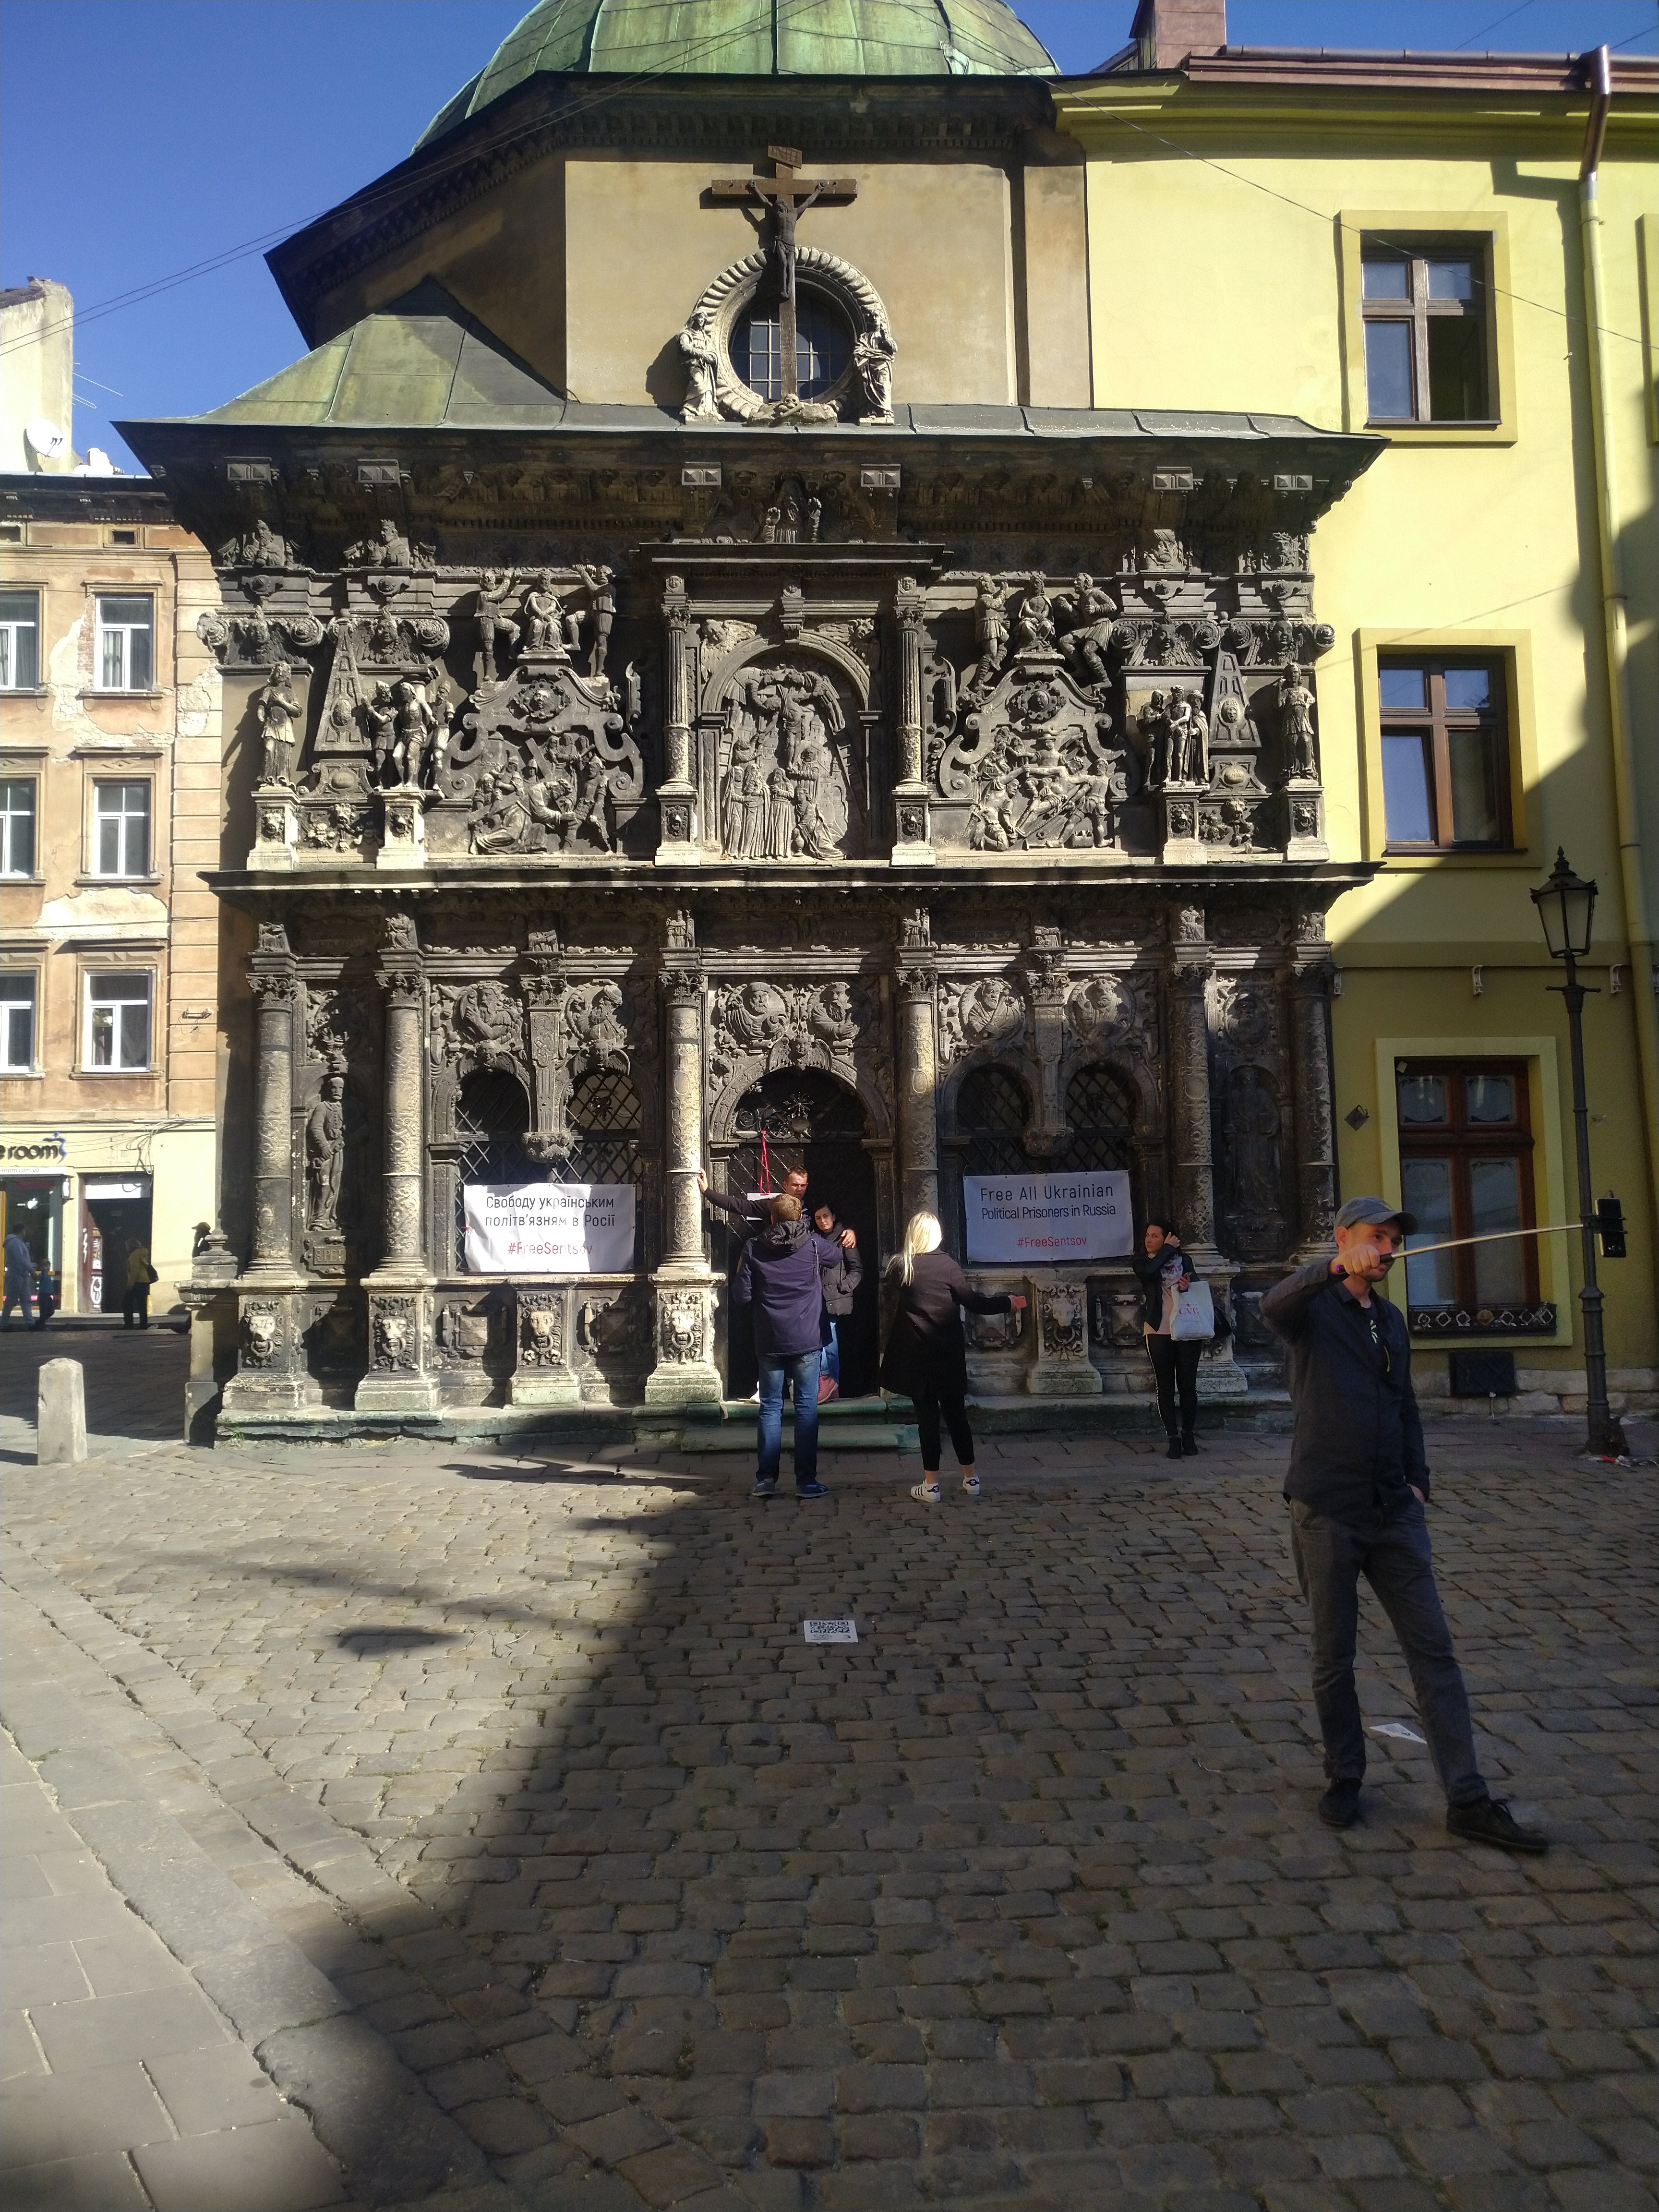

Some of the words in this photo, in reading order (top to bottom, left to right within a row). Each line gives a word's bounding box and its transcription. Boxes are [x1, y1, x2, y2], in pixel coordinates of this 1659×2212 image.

[8, 1145, 58, 1160] room
[980, 1188, 1012, 1201] Free
[1020, 1187, 1036, 1200] All
[1044, 1184, 1113, 1199] Ukrainian
[486, 1196, 535, 1209] Свободу
[539, 1195, 614, 1210] українським
[982, 1207, 1019, 1219] Political
[1022, 1206, 1069, 1218] Prisoners
[1071, 1205, 1080, 1217] in
[1082, 1204, 1116, 1216] Russia
[573, 1217, 578, 1226] в
[585, 1214, 615, 1226] Росії
[508, 1242, 592, 1254] #FreeSentsov
[1017, 1236, 1087, 1248] #FreeSentsov
